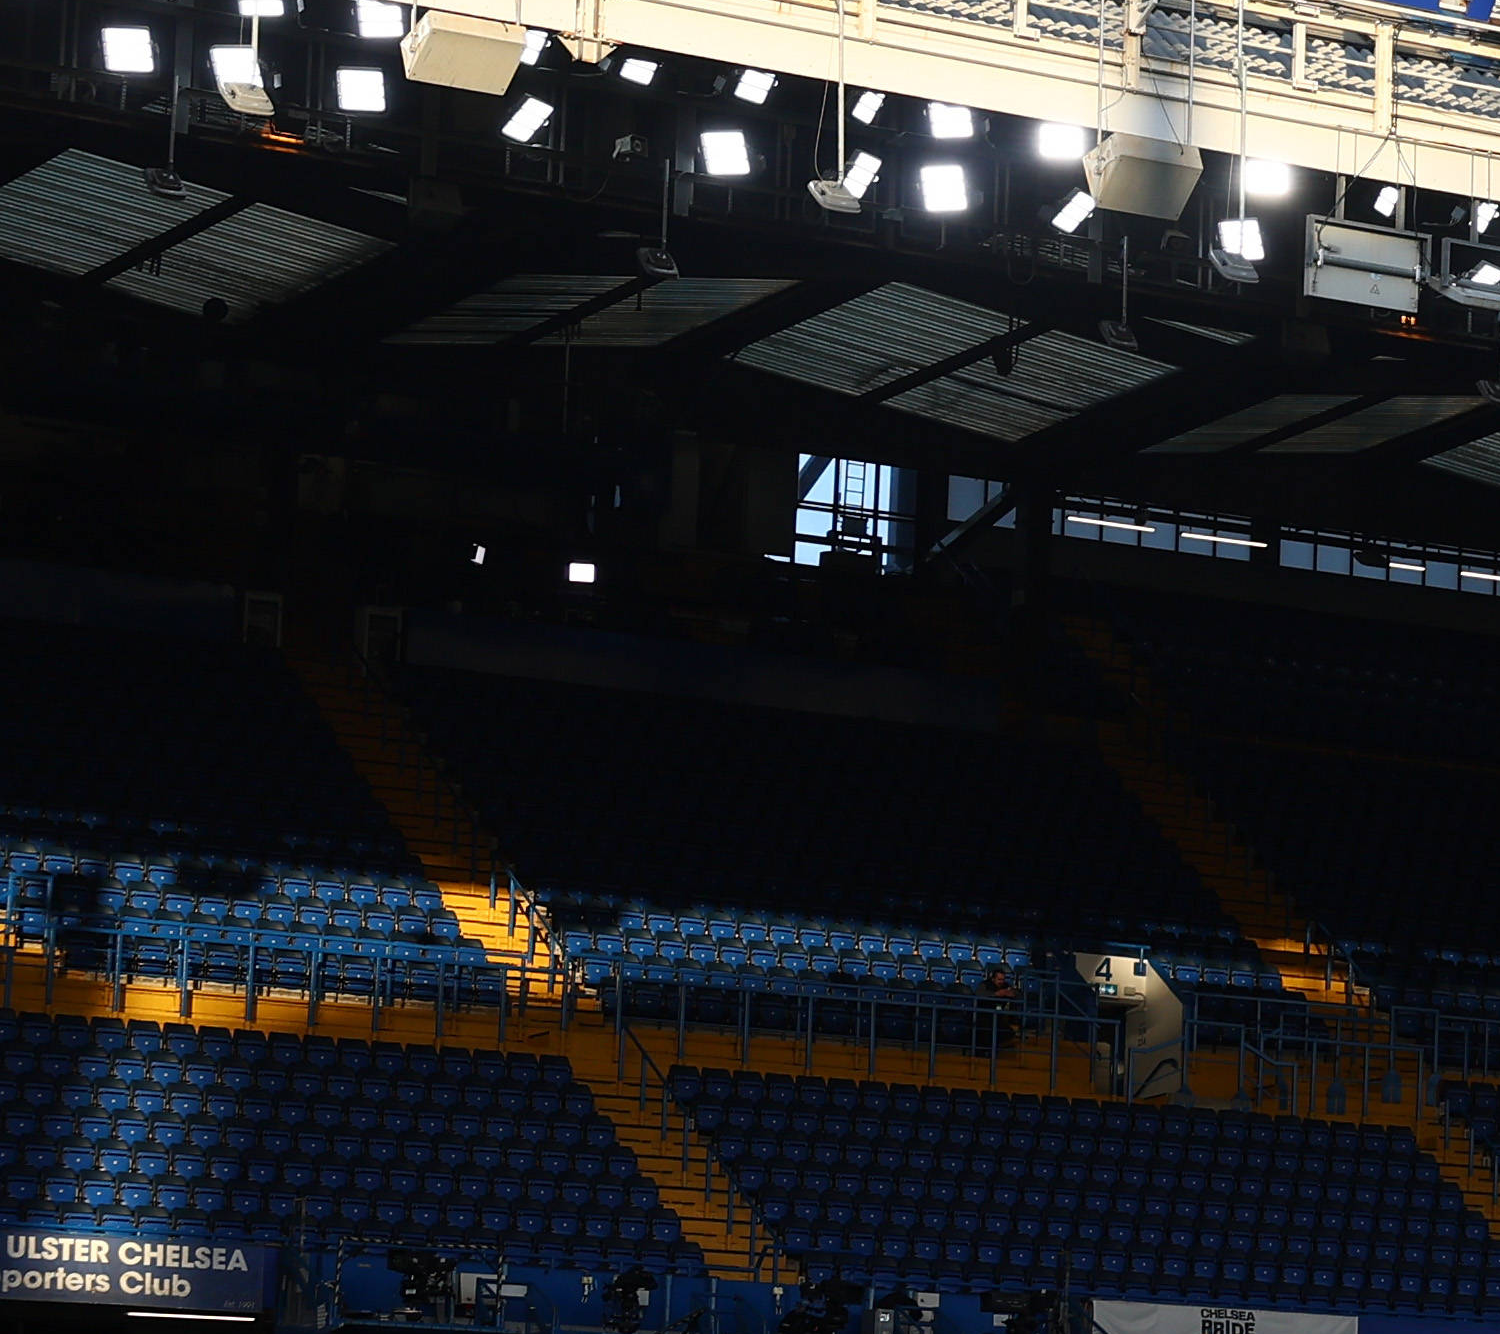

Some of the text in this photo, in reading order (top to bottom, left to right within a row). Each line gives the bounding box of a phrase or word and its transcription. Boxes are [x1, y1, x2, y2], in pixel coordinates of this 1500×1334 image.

[1095, 958, 1112, 981] 4
[6, 1235, 248, 1271] ULSTER CHELSEA
[120, 1271, 191, 1298] Club
[1201, 1309, 1256, 1322] CHELSEA
